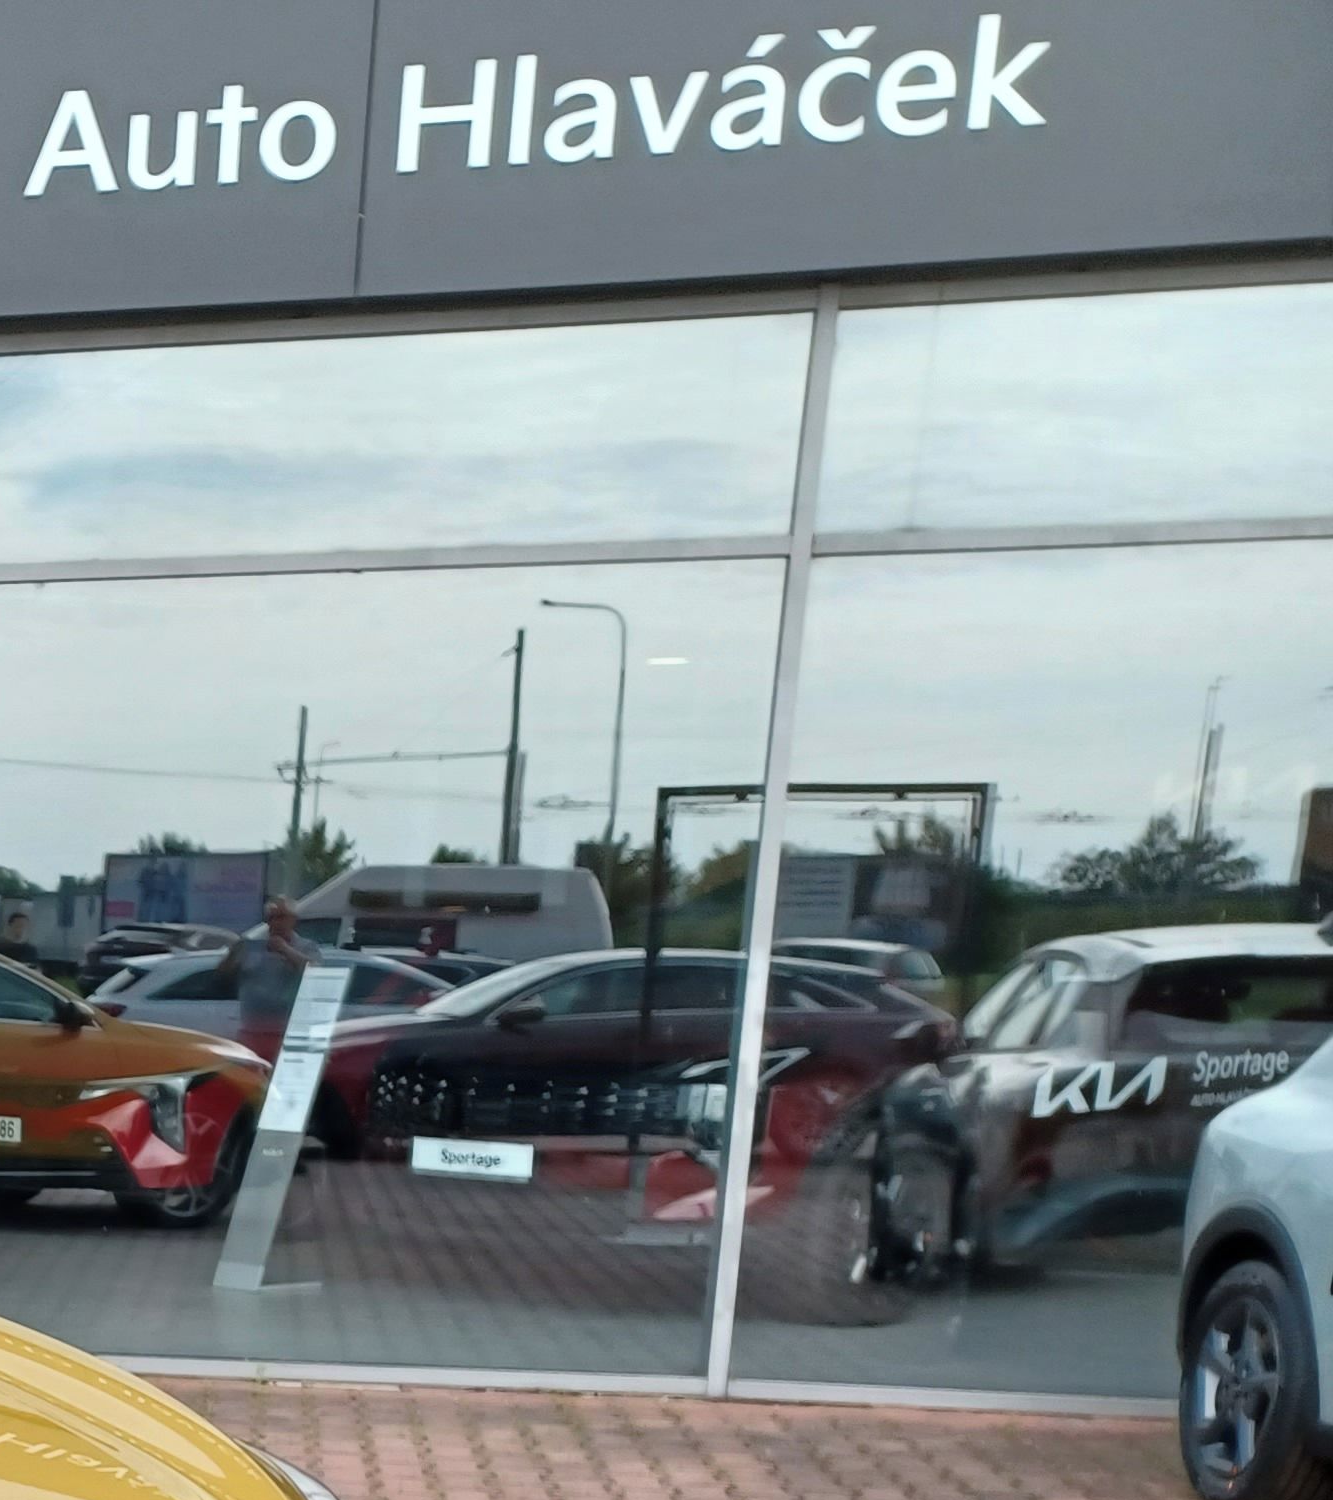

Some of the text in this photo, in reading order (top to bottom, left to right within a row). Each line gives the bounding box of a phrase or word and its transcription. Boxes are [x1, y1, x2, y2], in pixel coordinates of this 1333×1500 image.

[23, 13, 1051, 198] Auto Hlaváček
[1193, 1049, 1290, 1088] Sportage
[441, 1148, 501, 1168] Sportage
